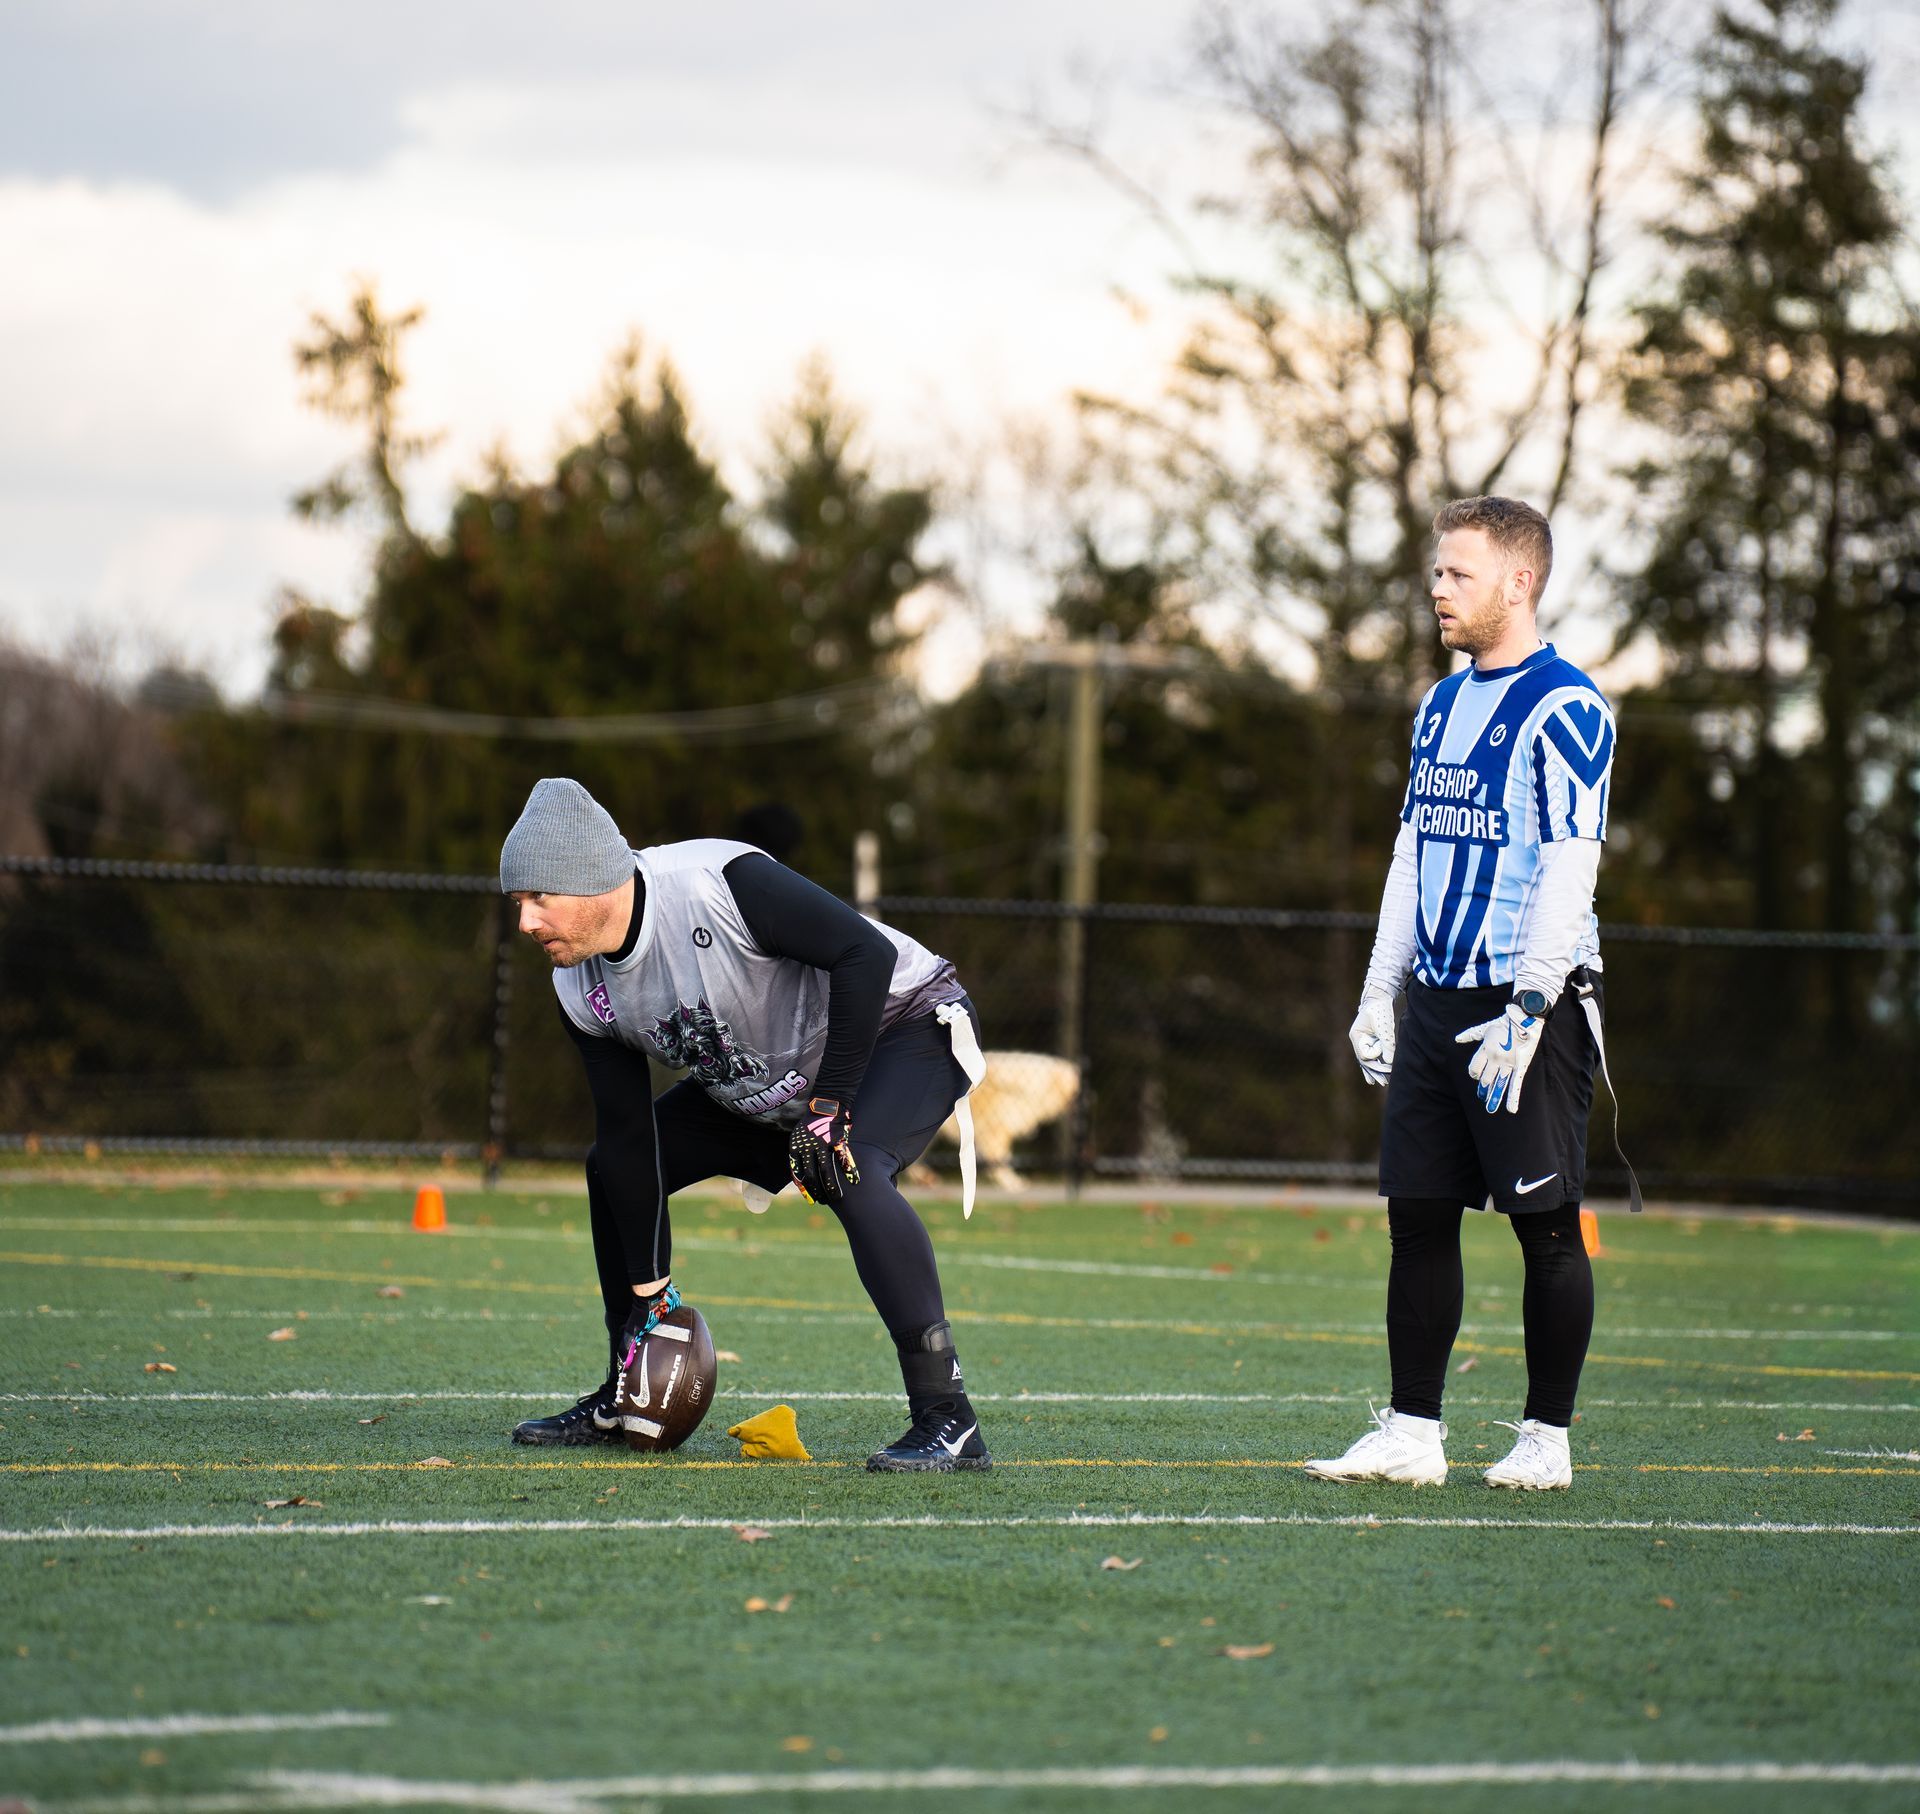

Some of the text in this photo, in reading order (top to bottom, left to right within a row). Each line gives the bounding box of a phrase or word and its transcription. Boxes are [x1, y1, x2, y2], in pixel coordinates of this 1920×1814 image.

[1421, 713, 1442, 747] 3
[1416, 757, 1478, 799] BISHOP
[733, 1070, 807, 1115] HOUNDS
[691, 1380, 703, 1400] CORY
